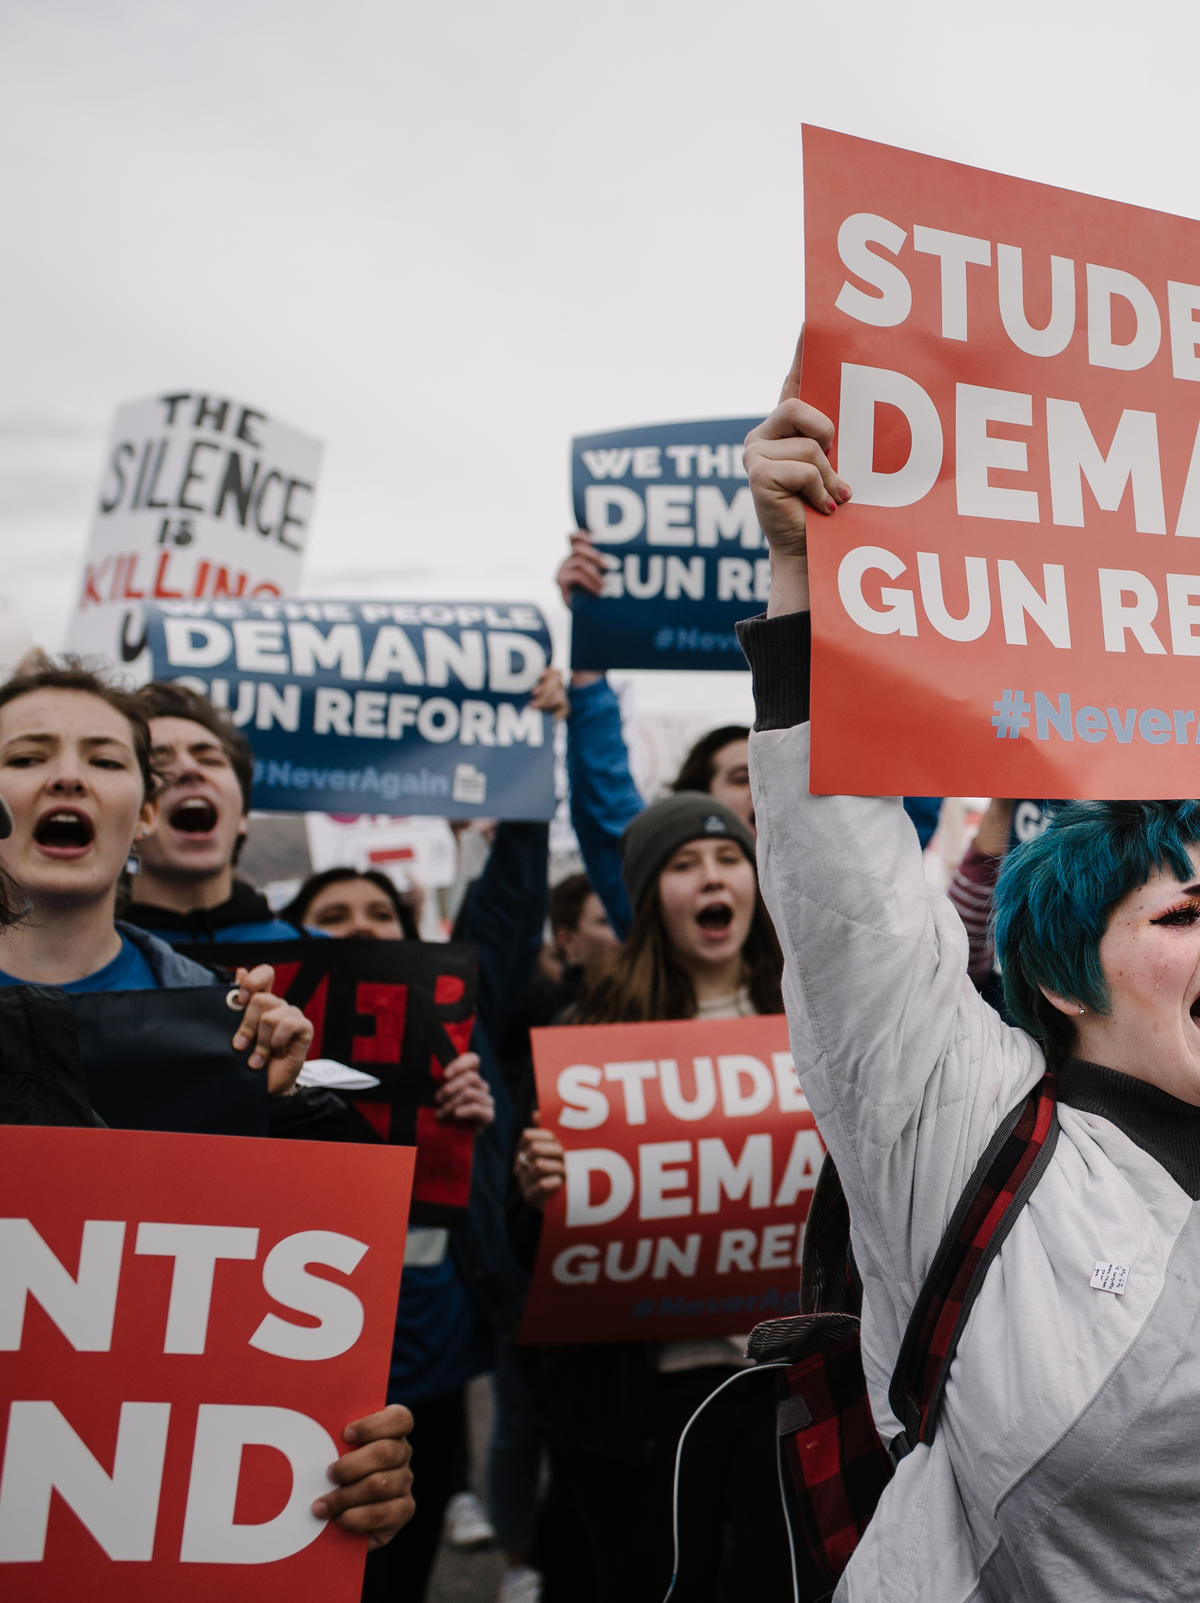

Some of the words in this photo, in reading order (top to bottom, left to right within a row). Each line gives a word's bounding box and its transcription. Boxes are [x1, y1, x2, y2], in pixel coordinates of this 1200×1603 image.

[159, 393, 266, 450] THE
[101, 437, 314, 554] SILENCE
[581, 446, 663, 480] WE
[584, 484, 769, 549] DEM
[251, 603, 357, 622] THE
[361, 604, 544, 632] PEOPLE
[837, 545, 1072, 650] GUN
[163, 617, 548, 695] DEMAND
[313, 686, 545, 748] REFORM
[555, 1050, 814, 1131] STUDE
[563, 1128, 828, 1229] DEMA
[0, 1217, 370, 1362] NTS
[551, 1233, 702, 1286] GUN
[0, 1401, 342, 1565] ND
